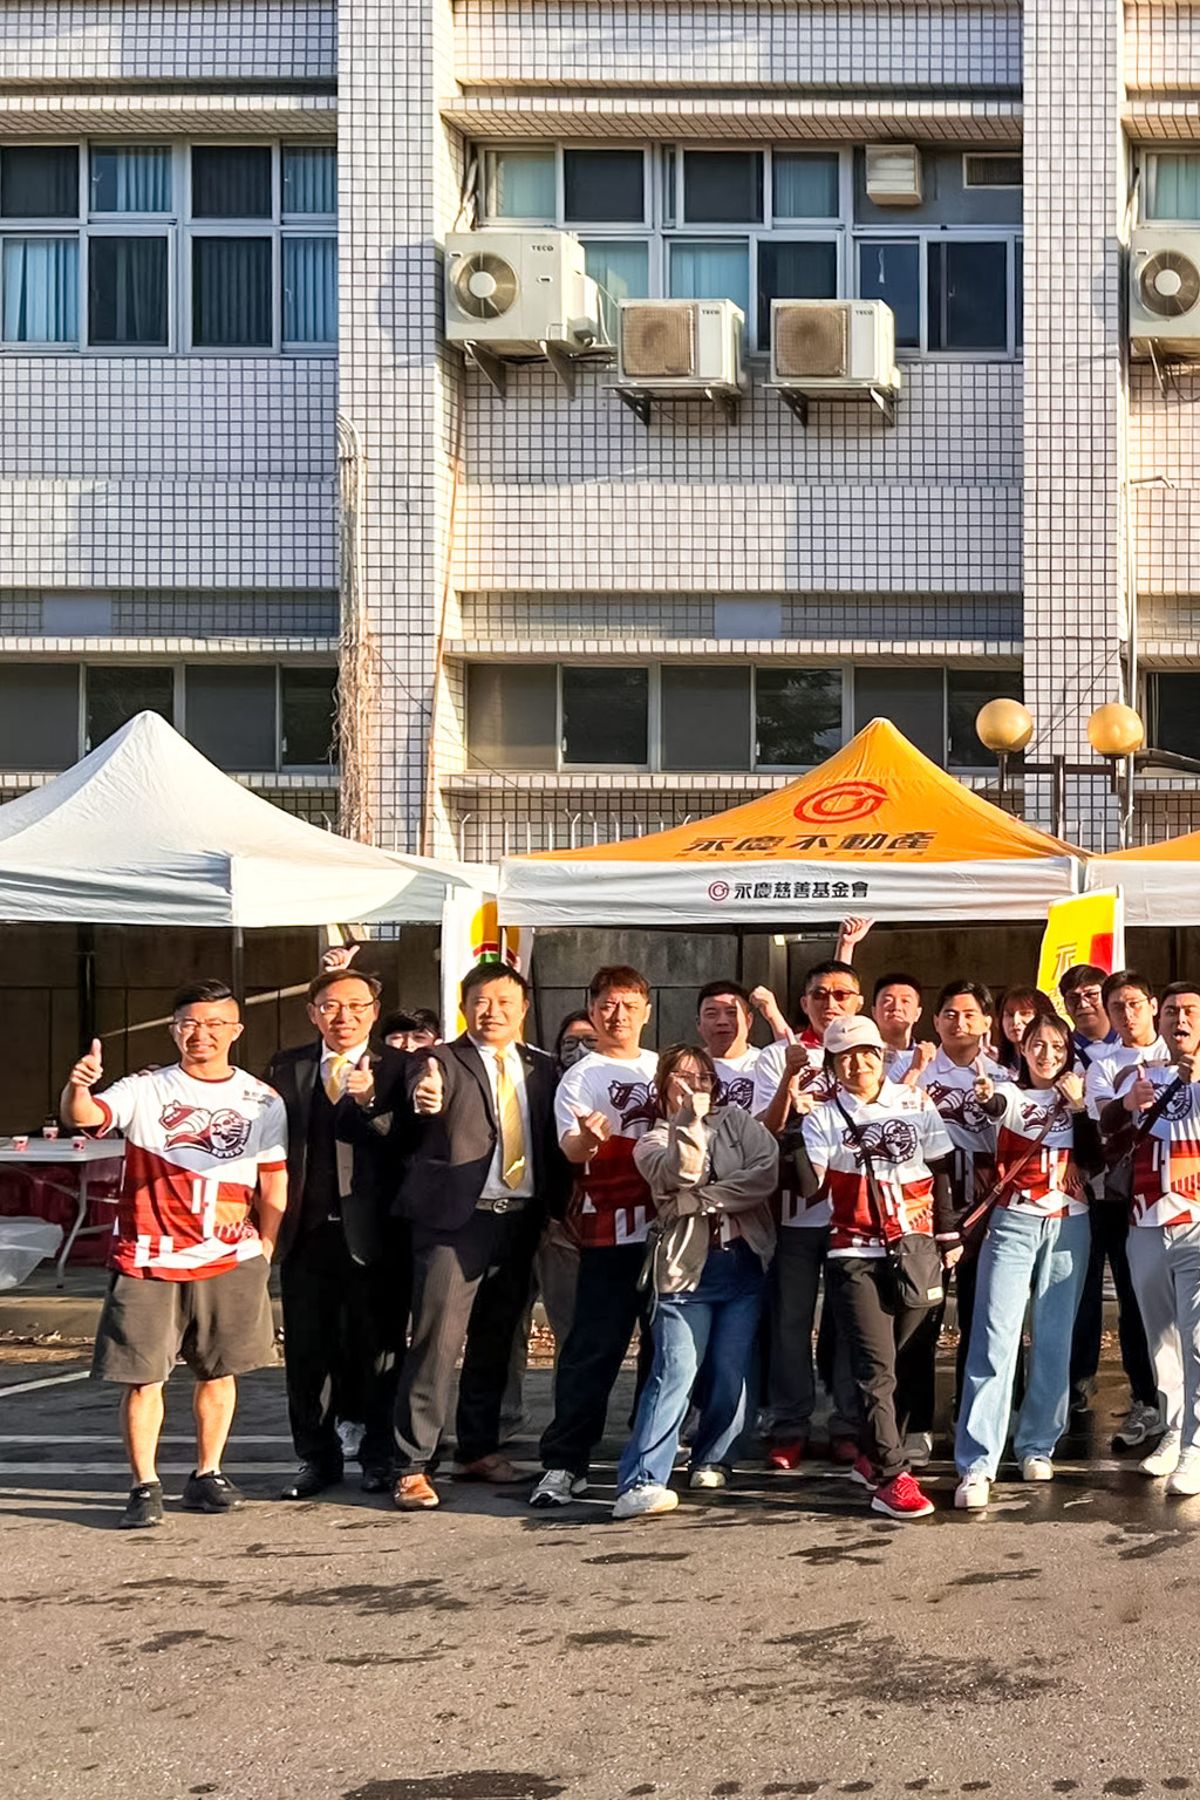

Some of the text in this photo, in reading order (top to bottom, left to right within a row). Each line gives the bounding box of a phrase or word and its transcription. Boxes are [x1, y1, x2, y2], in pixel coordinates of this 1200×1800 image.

[532, 244, 554, 252] TECO
[682, 831, 938, 852] 永慶不動產
[734, 881, 868, 899] 永慶慈善基金會
